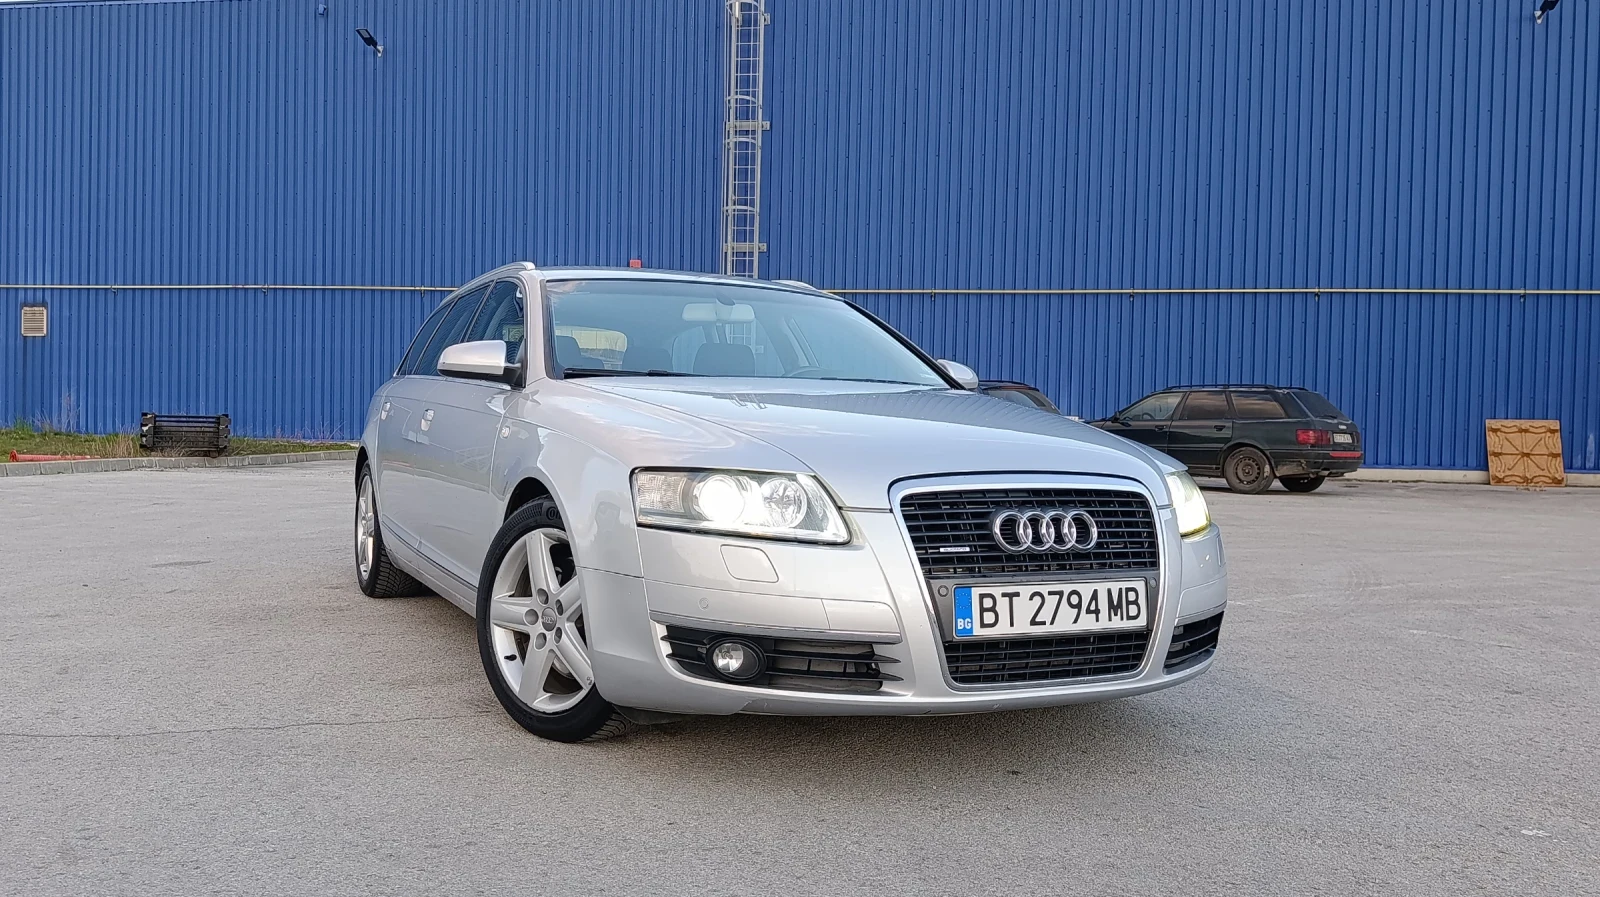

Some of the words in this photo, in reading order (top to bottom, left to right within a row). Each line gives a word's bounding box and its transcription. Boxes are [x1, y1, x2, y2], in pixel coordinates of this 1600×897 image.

[978, 592, 1021, 629] BT
[1028, 588, 1101, 627] 2794
[1107, 587, 1142, 622] MB
[957, 618, 972, 630] BG
